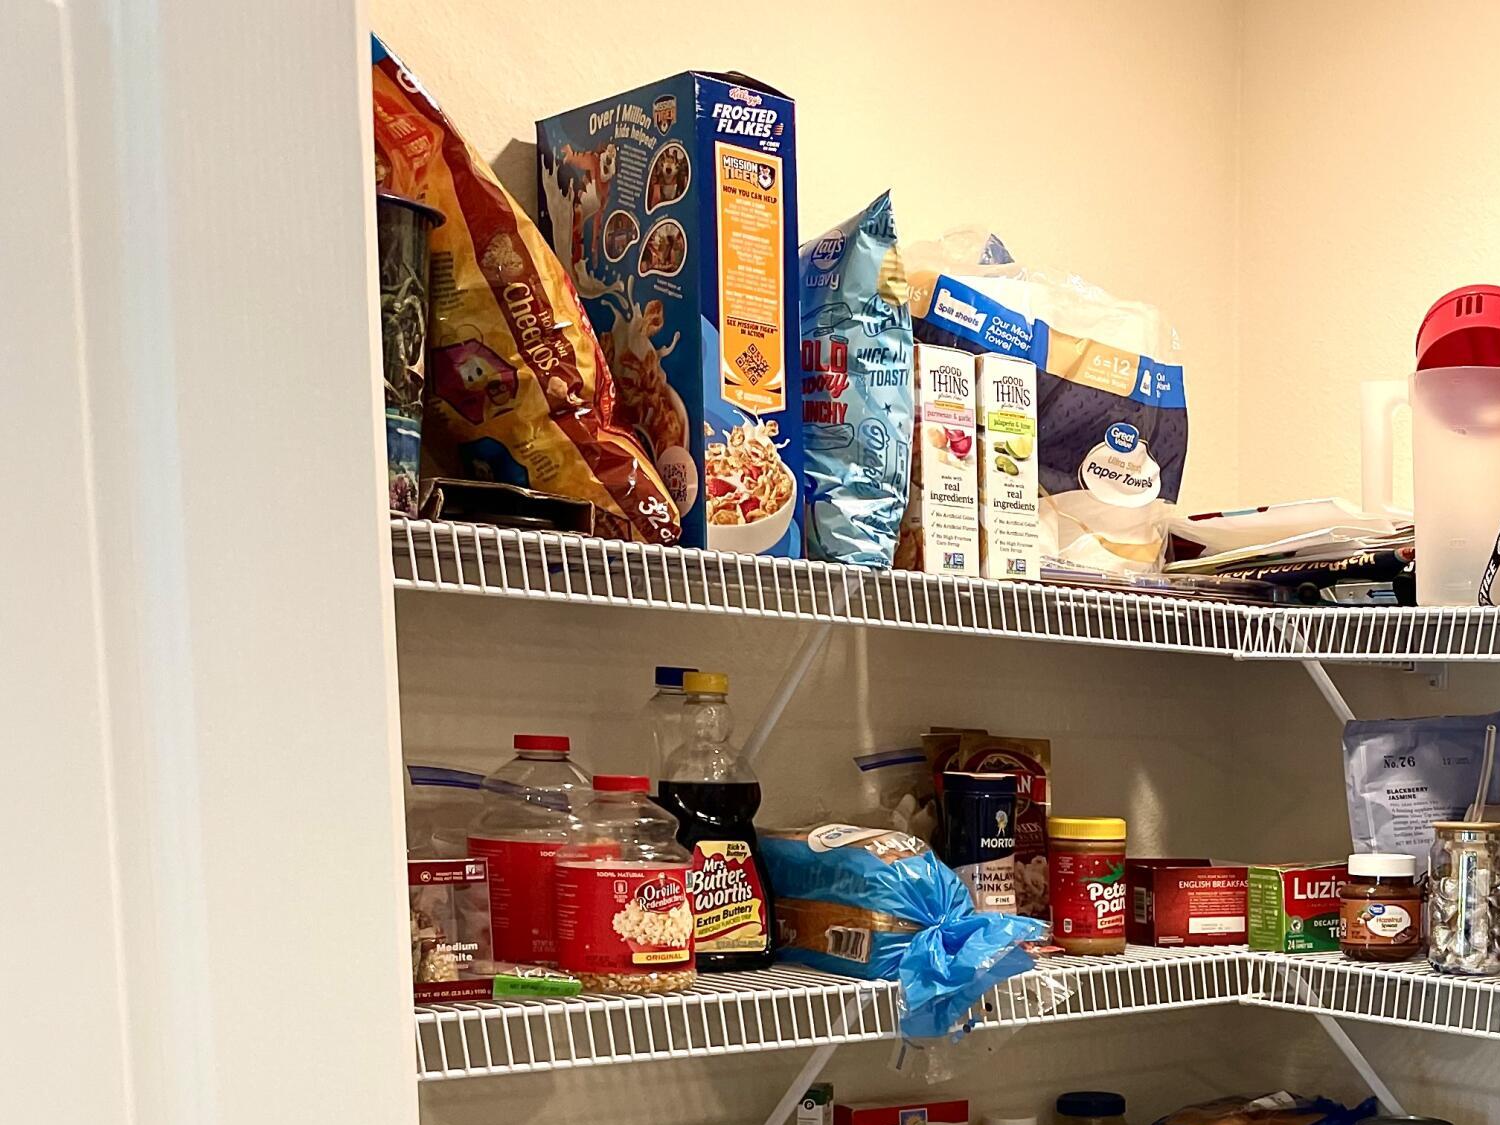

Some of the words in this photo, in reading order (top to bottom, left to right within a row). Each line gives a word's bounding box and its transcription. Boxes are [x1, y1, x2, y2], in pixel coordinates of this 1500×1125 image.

[589, 104, 614, 136] Over
[616, 104, 621, 122] 1
[622, 104, 652, 130] Million
[712, 104, 778, 124] FROSTED
[615, 121, 630, 139] kids
[631, 125, 657, 150] helped!
[716, 118, 772, 138] FLAKES
[722, 154, 758, 173] MISSION
[724, 169, 758, 191] TIGER
[722, 185, 736, 196] HOW
[738, 188, 750, 198] YOU
[750, 191, 763, 201] CAN
[764, 193, 778, 204] HELP
[806, 273, 840, 291] wavy
[938, 303, 954, 316] Split
[955, 310, 980, 327] sheets
[503, 282, 561, 371] Cheerios
[738, 321, 758, 330] MISSION
[992, 316, 1009, 330] Our
[1010, 324, 1034, 343] Most
[984, 331, 1012, 352] Towel
[870, 369, 910, 388] TOASTY
[939, 366, 962, 377] GOOD
[930, 370, 969, 398] THINS
[1002, 376, 1024, 388] GOOD
[993, 380, 1031, 407] THINS
[928, 410, 952, 420] parmesan
[958, 414, 972, 422] garlic
[1110, 427, 1136, 443] Great
[1114, 438, 1133, 449] Value
[1087, 461, 1122, 481] Paper
[944, 482, 960, 492] real
[1007, 490, 1022, 500] real
[930, 490, 974, 504] ingredients
[994, 498, 1036, 511] ingredients
[638, 496, 672, 530] 32
[1386, 786, 1428, 794] BLACKBERRY
[703, 858, 726, 873] Mrs.
[644, 882, 680, 900] Orville
[692, 868, 747, 895] Butter-
[976, 883, 1002, 892] PINK
[1178, 880, 1211, 888] ENGLISH
[696, 881, 752, 911] worth's
[696, 914, 721, 928] Extra
[722, 904, 752, 920] Buttery
[1094, 897, 1126, 918] Pan
[1376, 916, 1403, 924] Hazelnut
[436, 942, 478, 952] Medium
[1288, 940, 1296, 950] 24
